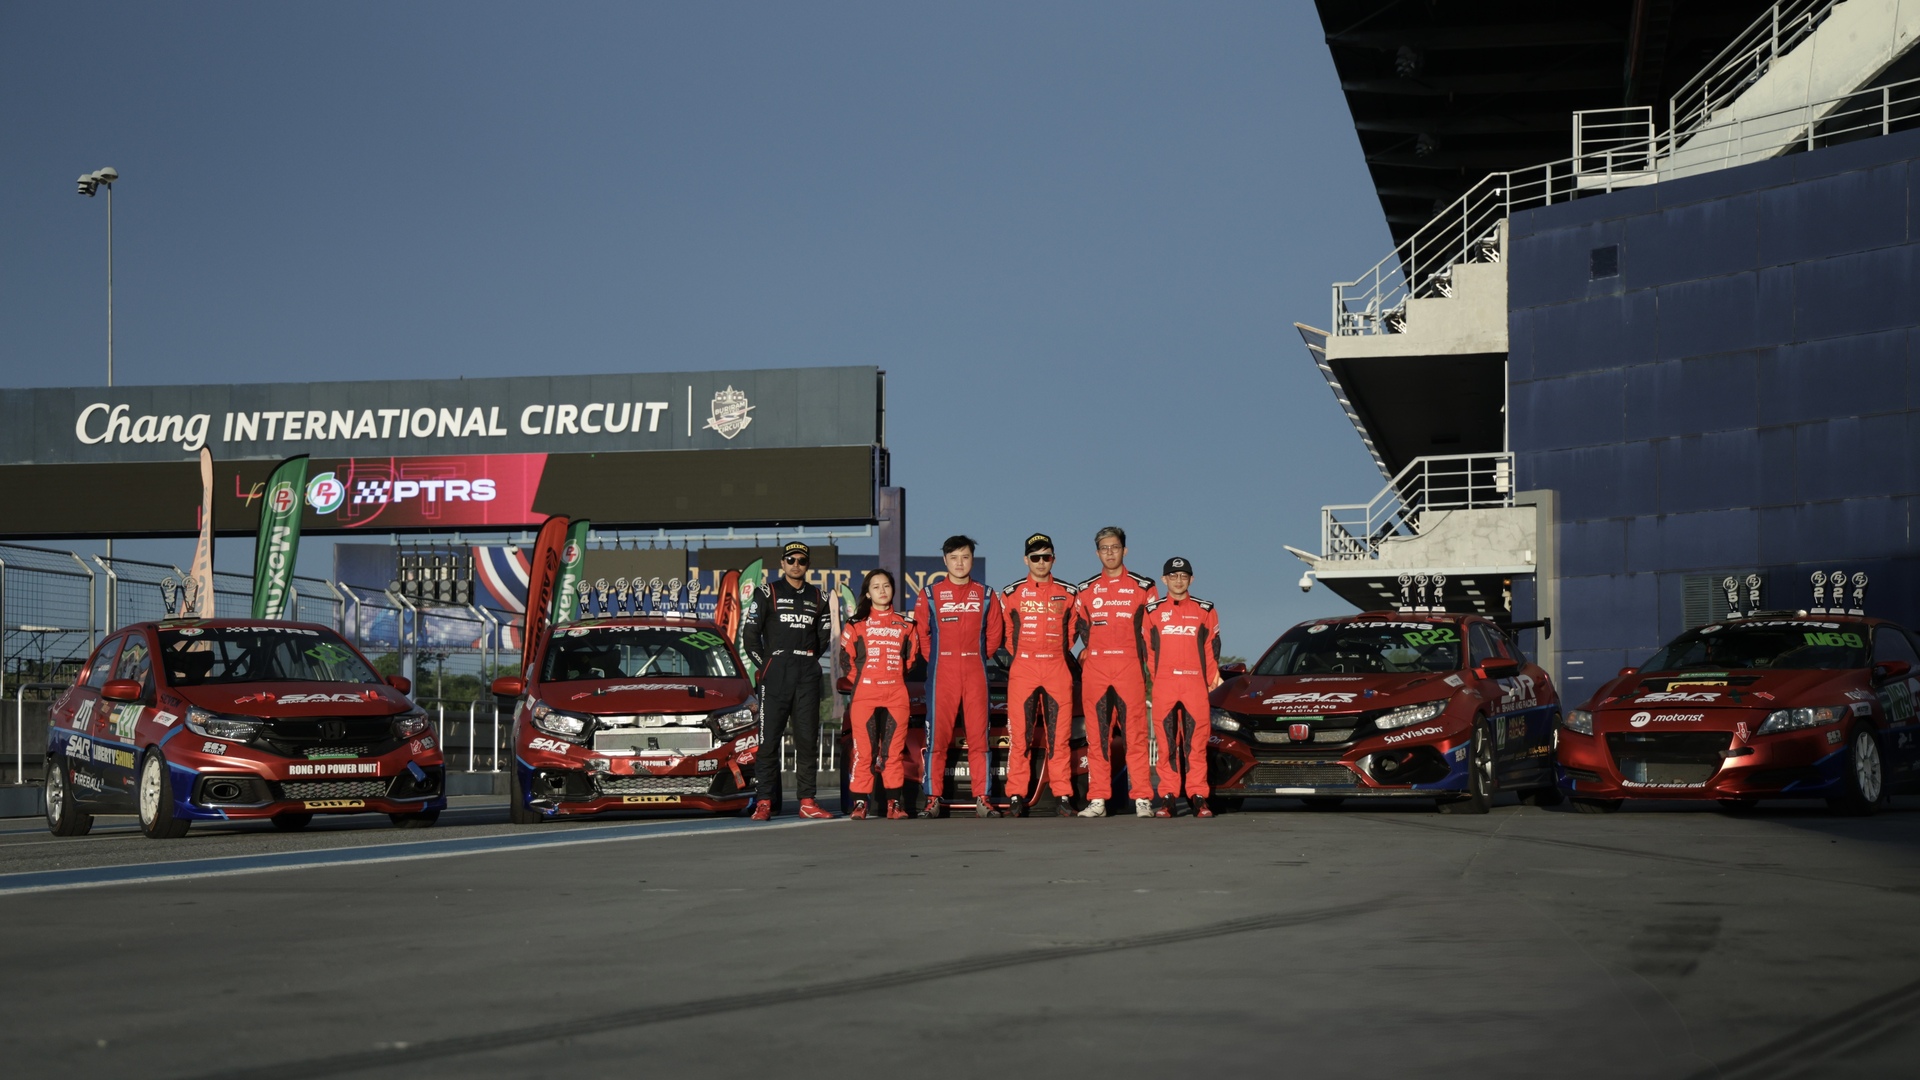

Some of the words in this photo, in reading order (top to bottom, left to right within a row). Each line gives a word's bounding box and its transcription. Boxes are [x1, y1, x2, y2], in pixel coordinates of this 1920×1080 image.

[75, 402, 211, 452] Chang
[222, 406, 508, 443] INTERNATIONAL
[520, 402, 669, 435] CIRCUIT
[393, 478, 497, 503] PTRS
[1401, 587, 1409, 597] 1
[1417, 587, 1426, 597] 1
[1434, 588, 1443, 597] 4
[1728, 592, 1738, 602] 5
[1750, 590, 1760, 600] 2
[1814, 587, 1824, 598] 2
[1833, 587, 1843, 598] 2
[1853, 589, 1864, 599] 4
[940, 602, 981, 611] SAR
[780, 613, 815, 626] SEVEN
[1162, 624, 1197, 634] SAR
[1368, 621, 1433, 630] PTRS
[1767, 621, 1841, 629] PTRS
[679, 631, 726, 651] E19
[1402, 627, 1461, 648] R22
[1803, 632, 1864, 649] N69
[1271, 692, 1358, 700] SAR
[1644, 692, 1722, 700] SAR
[1652, 713, 1705, 722] motorist
[67, 735, 91, 757] SAR
[530, 737, 570, 752] SAR
[289, 765, 313, 775] RONG
[315, 765, 326, 775] PO
[327, 764, 356, 775] POWER
[358, 763, 378, 774] UNIT
[74, 772, 102, 793] FIREBALL
